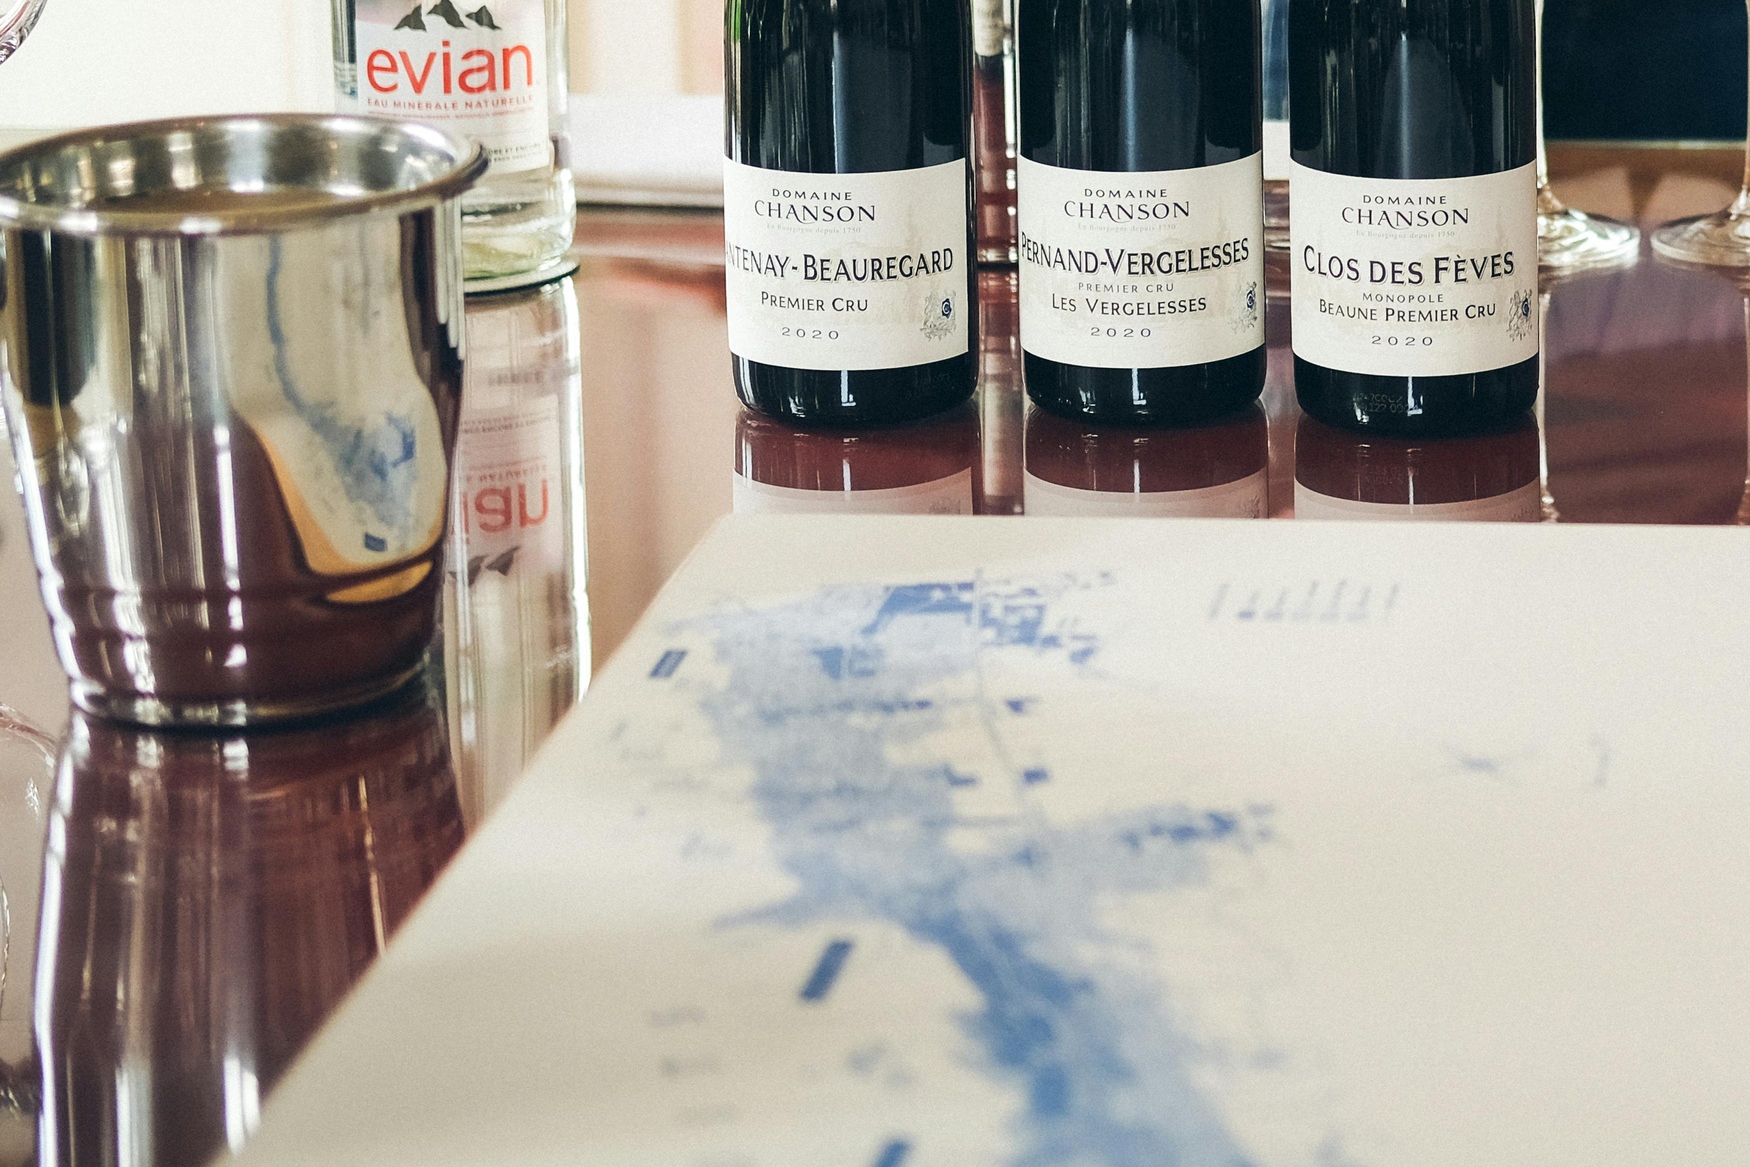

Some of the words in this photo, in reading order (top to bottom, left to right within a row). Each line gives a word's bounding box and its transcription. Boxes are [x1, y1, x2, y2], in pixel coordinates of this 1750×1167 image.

[366, 40, 533, 95] evian
[368, 98, 388, 109] EAU
[465, 95, 533, 110] NATURELLE
[772, 188, 852, 201] DOMAINE
[1085, 189, 1167, 198] DOMAINE
[1363, 195, 1446, 205] DOMAINE
[754, 200, 876, 224] CHANSON
[1064, 201, 1189, 223] CHANSON
[1342, 207, 1469, 230] CHANSON
[1021, 231, 1249, 275] PERNAND-VERGELESSES
[1304, 245, 1360, 281] CLOS
[1369, 261, 1423, 284] DES
[1434, 251, 1514, 284] FÈVES
[1078, 282, 1138, 293] PREMIER
[1146, 283, 1174, 293] CRU
[761, 291, 824, 311] PREMIER
[832, 298, 868, 312] CRU
[1052, 294, 1076, 312] LES
[1086, 298, 1207, 315] VERGELESSES
[1362, 292, 1444, 303] MONOPOLE
[1320, 299, 1377, 321] BEAUNE
[1385, 308, 1458, 322] PREMIER
[1465, 303, 1496, 319] CRU
[781, 327, 839, 340] 2020
[1091, 327, 1151, 337] 2020
[1371, 335, 1433, 346] 2020
